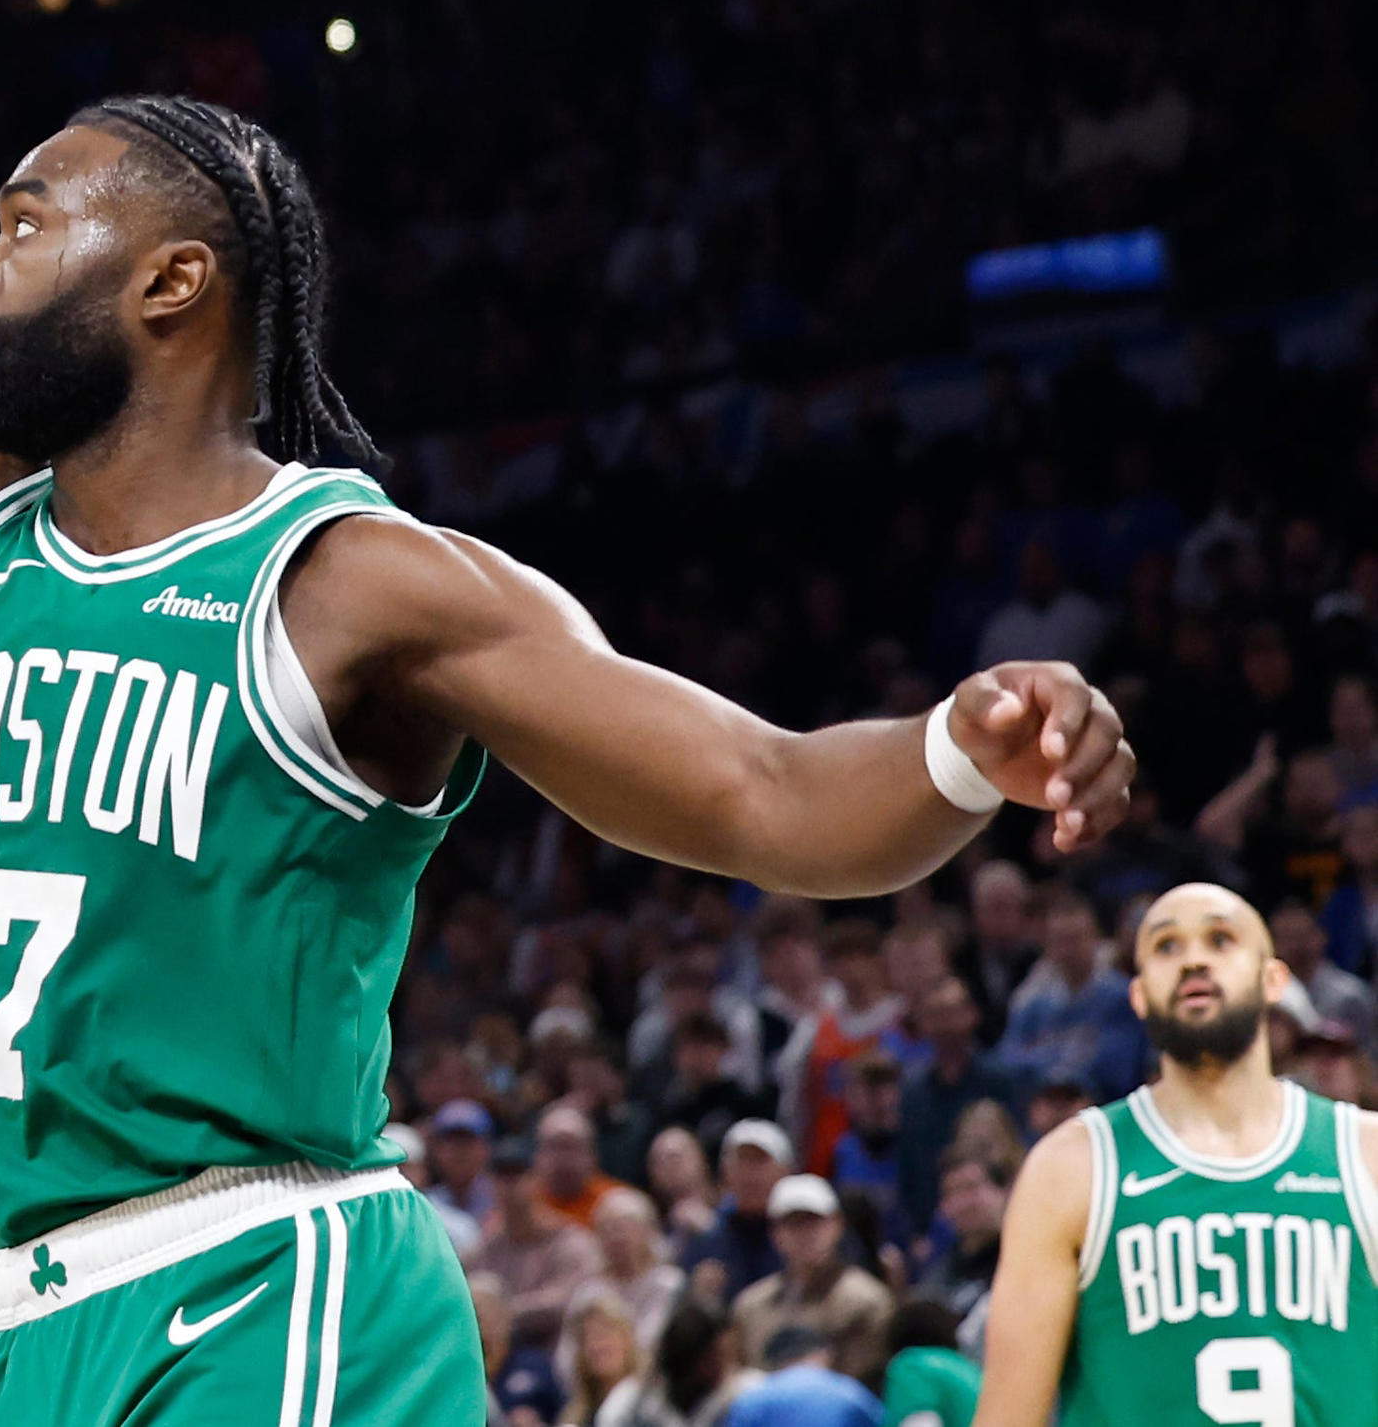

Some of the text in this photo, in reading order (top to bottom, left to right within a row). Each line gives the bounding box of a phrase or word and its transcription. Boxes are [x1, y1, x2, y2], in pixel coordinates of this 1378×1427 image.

[142, 584, 240, 623] Amica
[1115, 1212, 1352, 1335] BOSTON
[1195, 1335, 1296, 1427] 9
